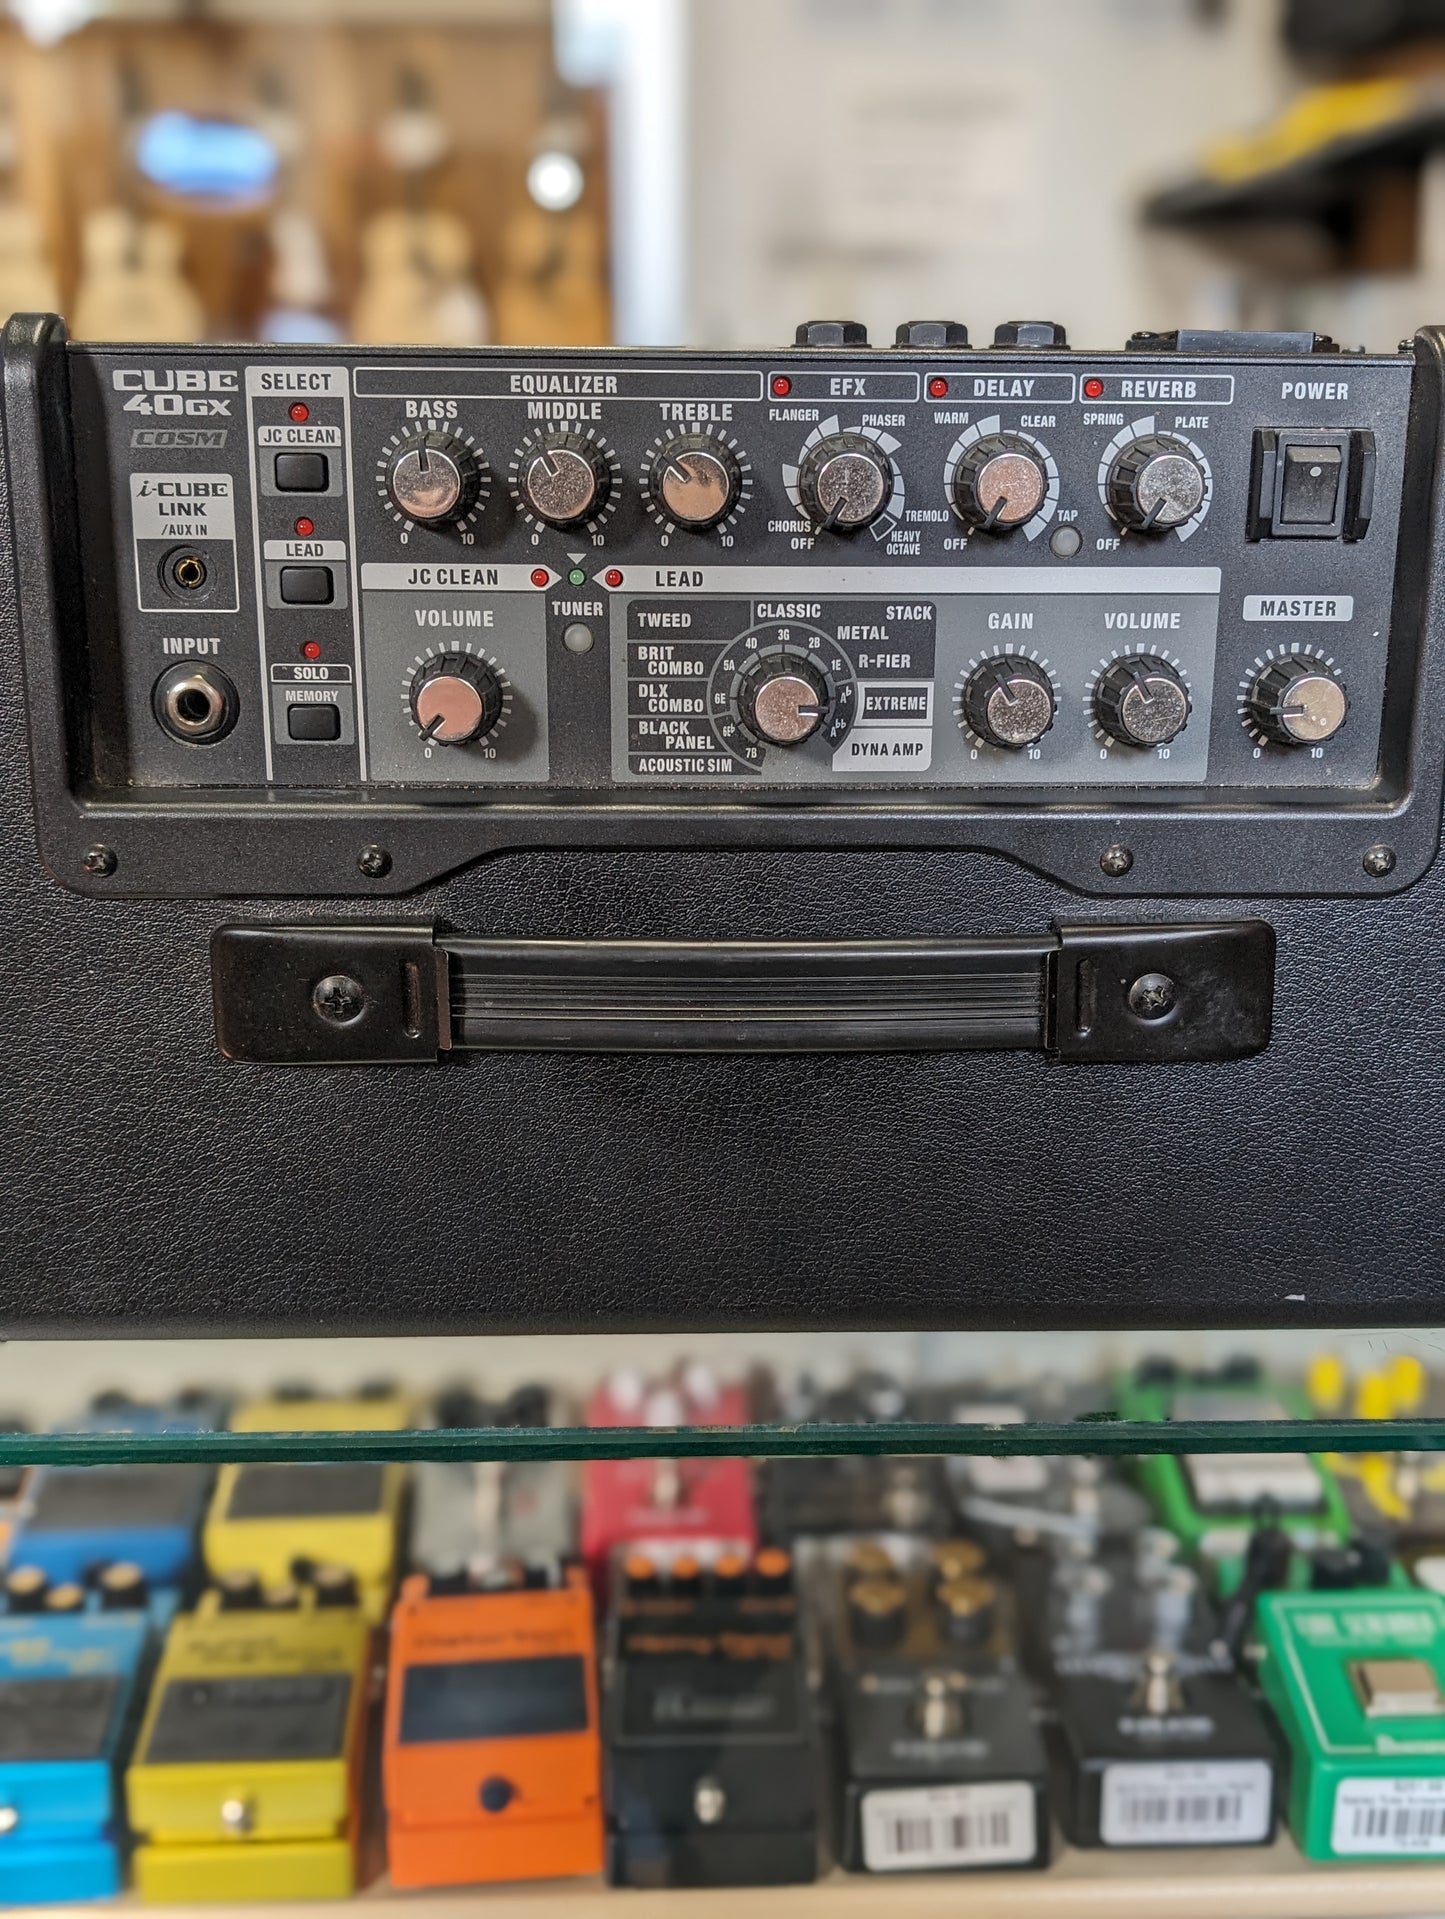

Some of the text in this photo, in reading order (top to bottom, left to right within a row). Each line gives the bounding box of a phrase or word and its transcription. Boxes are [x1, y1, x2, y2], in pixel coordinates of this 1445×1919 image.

[112, 370, 239, 392] CUBE
[261, 373, 332, 391] SELECT
[510, 375, 618, 395] EQUALIZER
[830, 378, 866, 396] EFX
[973, 379, 1035, 397] DELAY
[1121, 380, 1197, 398] REVERB
[1281, 382, 1349, 400] POWER
[123, 394, 232, 416] 40GX
[405, 400, 458, 419] BASS
[527, 402, 602, 420] MIDDLE
[659, 403, 733, 421] TREBLE
[769, 409, 819, 422] FLANGER
[933, 412, 969, 424] WARM
[862, 414, 905, 427] PHASER
[1020, 415, 1056, 428] CLEAR
[1083, 413, 1124, 426] SPRING
[1175, 416, 1209, 429] PLATE
[135, 430, 223, 447] COSM
[263, 429, 336, 444] JC CLEAN
[159, 503, 207, 517] LINK
[905, 510, 949, 523] TREMOLO
[1057, 510, 1078, 522] TAP
[195, 524, 208, 536] IN
[767, 520, 811, 533] CHORUS
[400, 533, 409, 545] 0
[460, 533, 475, 545] 10
[530, 534, 539, 546] 0
[591, 534, 605, 546] 10
[660, 536, 669, 547] 0
[720, 535, 734, 547] 10
[891, 530, 920, 543] HEAVY
[285, 543, 324, 557] LEAD
[790, 537, 815, 550] OFF
[886, 543, 921, 555] OCTAVE
[943, 538, 968, 551] OFF
[1096, 538, 1120, 551] OFF
[407, 568, 499, 586] JC CLEAN
[655, 571, 704, 587] LEAD
[551, 601, 604, 616] TUNER
[757, 603, 821, 618] CLASSIC
[886, 605, 932, 621] STACK
[1259, 600, 1337, 617] MASTER
[415, 609, 494, 627] VOLUME
[637, 613, 691, 628] TWEED
[988, 612, 1034, 630] GAIN
[1103, 612, 1181, 630] VOLUME
[777, 629, 790, 640] 3G
[837, 625, 889, 640] METAL
[162, 637, 221, 655] INPUT
[745, 637, 758, 649] 4D
[808, 637, 821, 648] 2B
[638, 646, 674, 661] BRIT
[723, 659, 735, 671] 5A
[831, 659, 842, 671] 1E
[858, 654, 911, 668] R-FIER
[293, 667, 329, 680] SOLO
[647, 661, 704, 675] COMBO
[285, 690, 339, 702] MEMORY
[638, 683, 668, 698] DLX
[714, 693, 726, 704] 6E
[866, 696, 927, 711] EXTREME
[647, 699, 704, 713] COMBO
[638, 720, 690, 735] BLACK
[665, 735, 715, 750] PANEL
[424, 747, 432, 759] 0
[482, 747, 496, 759] 10
[745, 747, 757, 758] 7B
[851, 743, 924, 757] DYNA AMP
[970, 748, 978, 760] 0
[1027, 748, 1041, 760] 10
[1099, 748, 1107, 760] 0
[1157, 748, 1170, 760] 10
[1253, 747, 1261, 759] 0
[1310, 747, 1323, 759] 10
[638, 758, 732, 773] ACOUSTIC SIM
